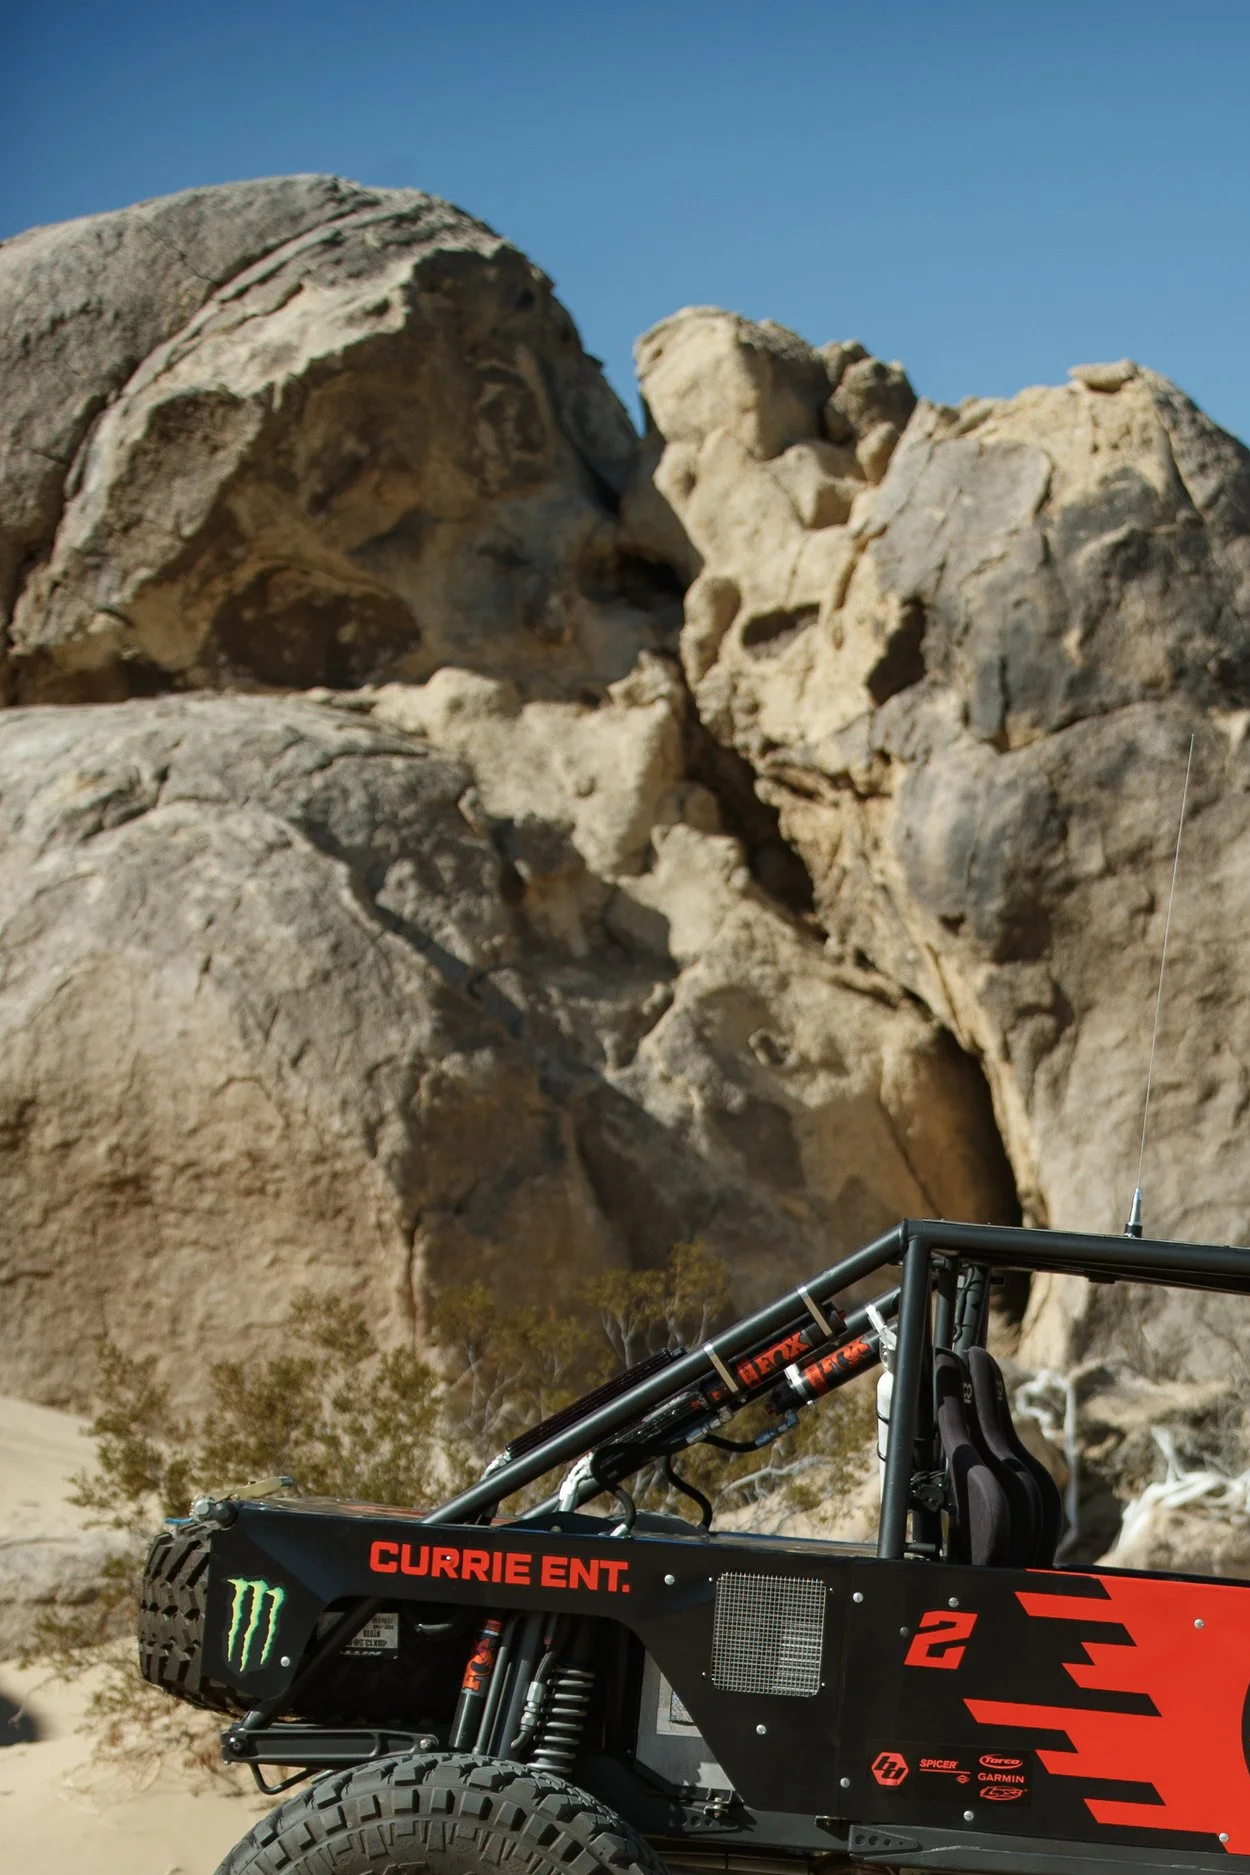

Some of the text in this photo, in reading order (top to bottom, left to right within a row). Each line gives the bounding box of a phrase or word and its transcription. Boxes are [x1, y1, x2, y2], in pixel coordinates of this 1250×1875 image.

[370, 1540, 631, 1593] CURRIE ENT.
[904, 1610, 978, 1670] 2
[919, 1758, 958, 1769] SPICER
[977, 1772, 1025, 1783] GARMIN
